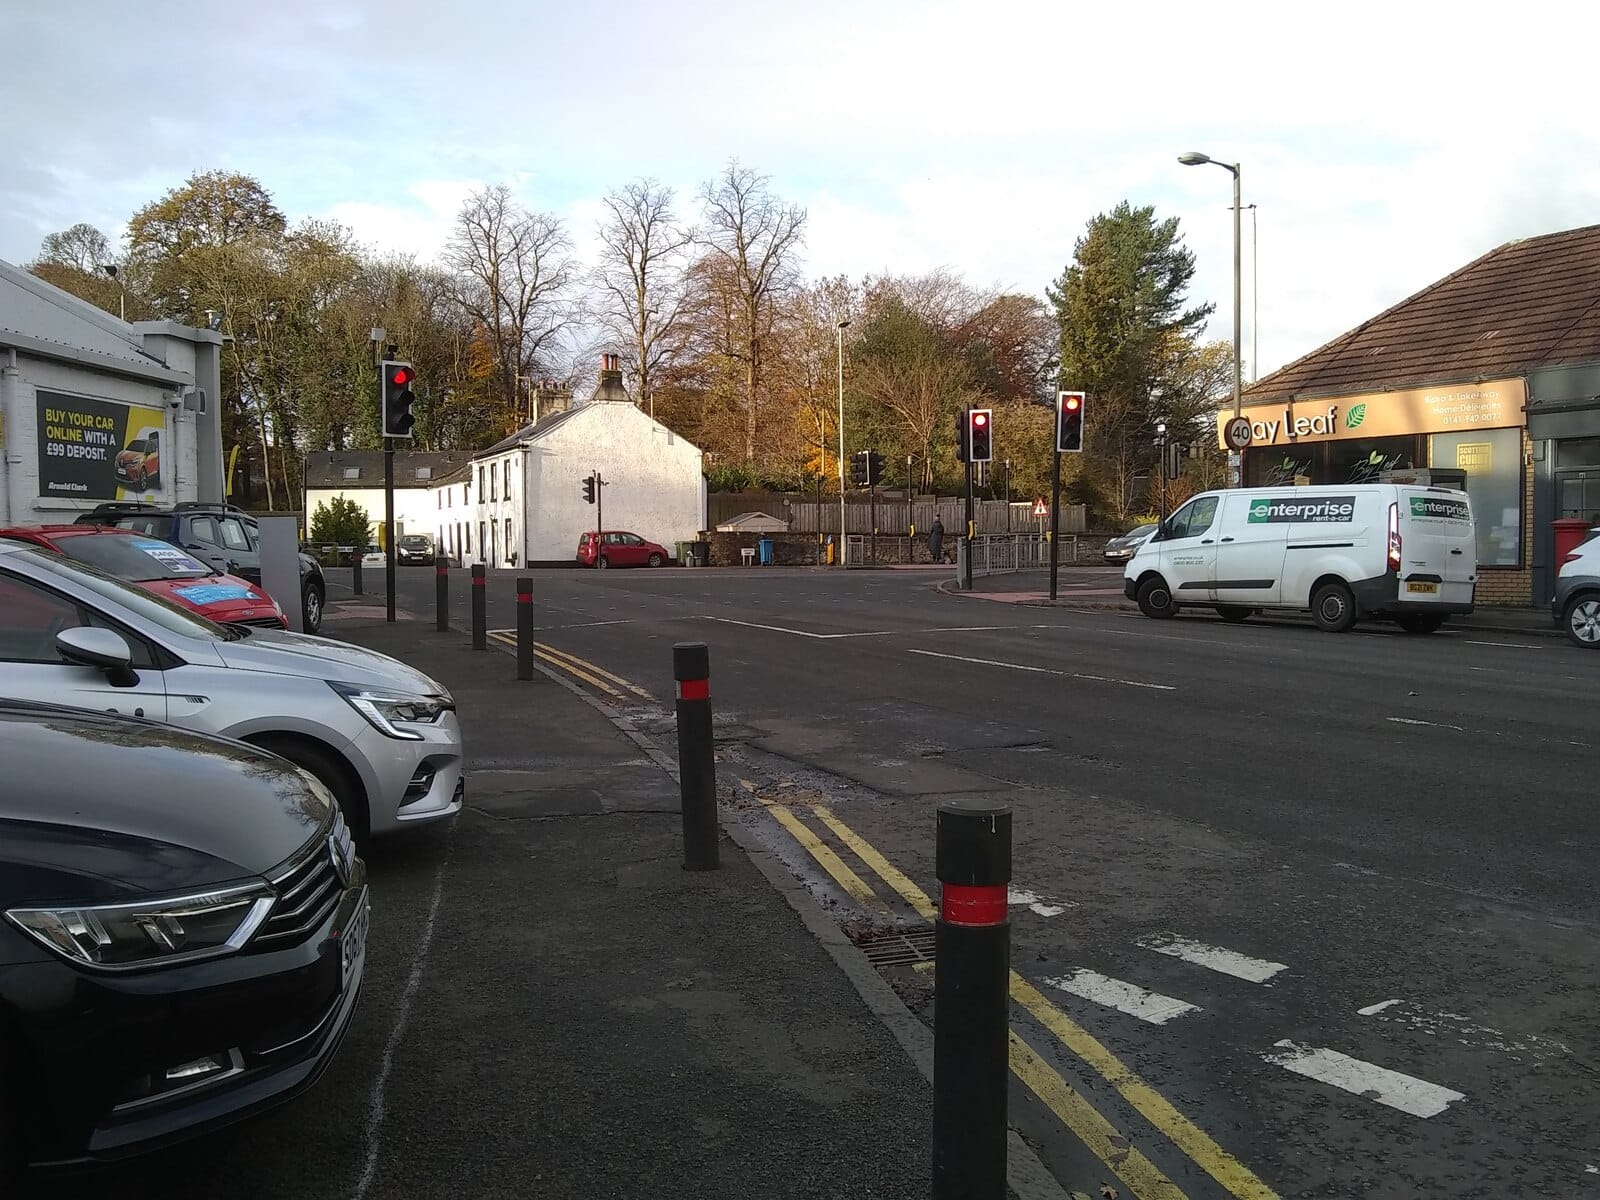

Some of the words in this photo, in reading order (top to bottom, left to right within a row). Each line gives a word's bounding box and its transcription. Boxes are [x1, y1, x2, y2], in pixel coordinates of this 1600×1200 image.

[45, 408, 65, 424] BUY
[68, 411, 94, 427] YOUR
[95, 416, 114, 430] CAR
[1432, 406, 1458, 415] Home
[1232, 426, 1250, 440] 40
[1252, 420, 1281, 444] ay
[1284, 404, 1338, 438] Leaf
[46, 425, 82, 442] ONLINE
[83, 430, 108, 445] WITH
[109, 433, 116, 446] A
[46, 442, 65, 457] £99
[66, 444, 107, 461] DEPOSIT.
[48, 481, 71, 490] Arnold
[71, 483, 88, 491] Clark
[1252, 501, 1353, 519] enterprise
[1413, 501, 1469, 516] enterprise
